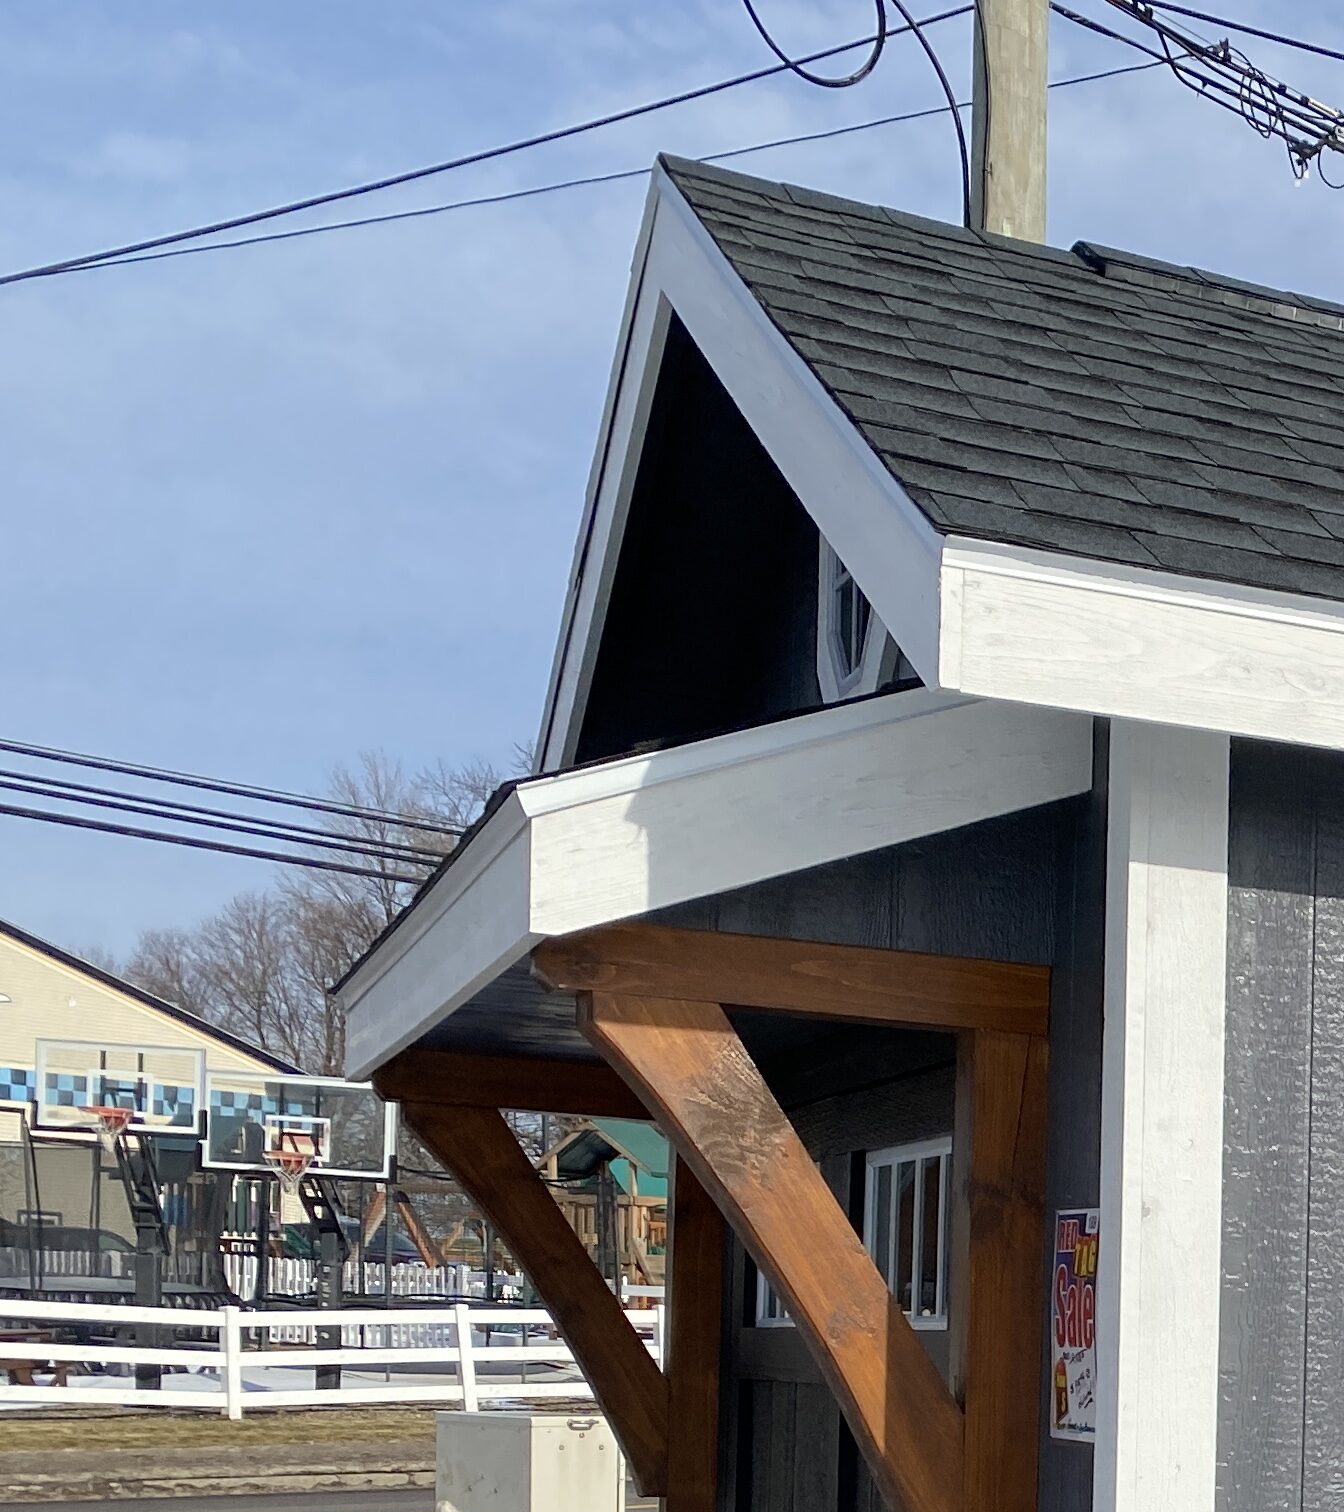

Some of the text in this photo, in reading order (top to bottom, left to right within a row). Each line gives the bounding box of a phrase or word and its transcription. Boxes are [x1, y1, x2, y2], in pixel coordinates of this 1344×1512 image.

[1059, 1219, 1079, 1252] RED
[1074, 1239, 1097, 1277] TAG
[1055, 1263, 1094, 1349] Sale
